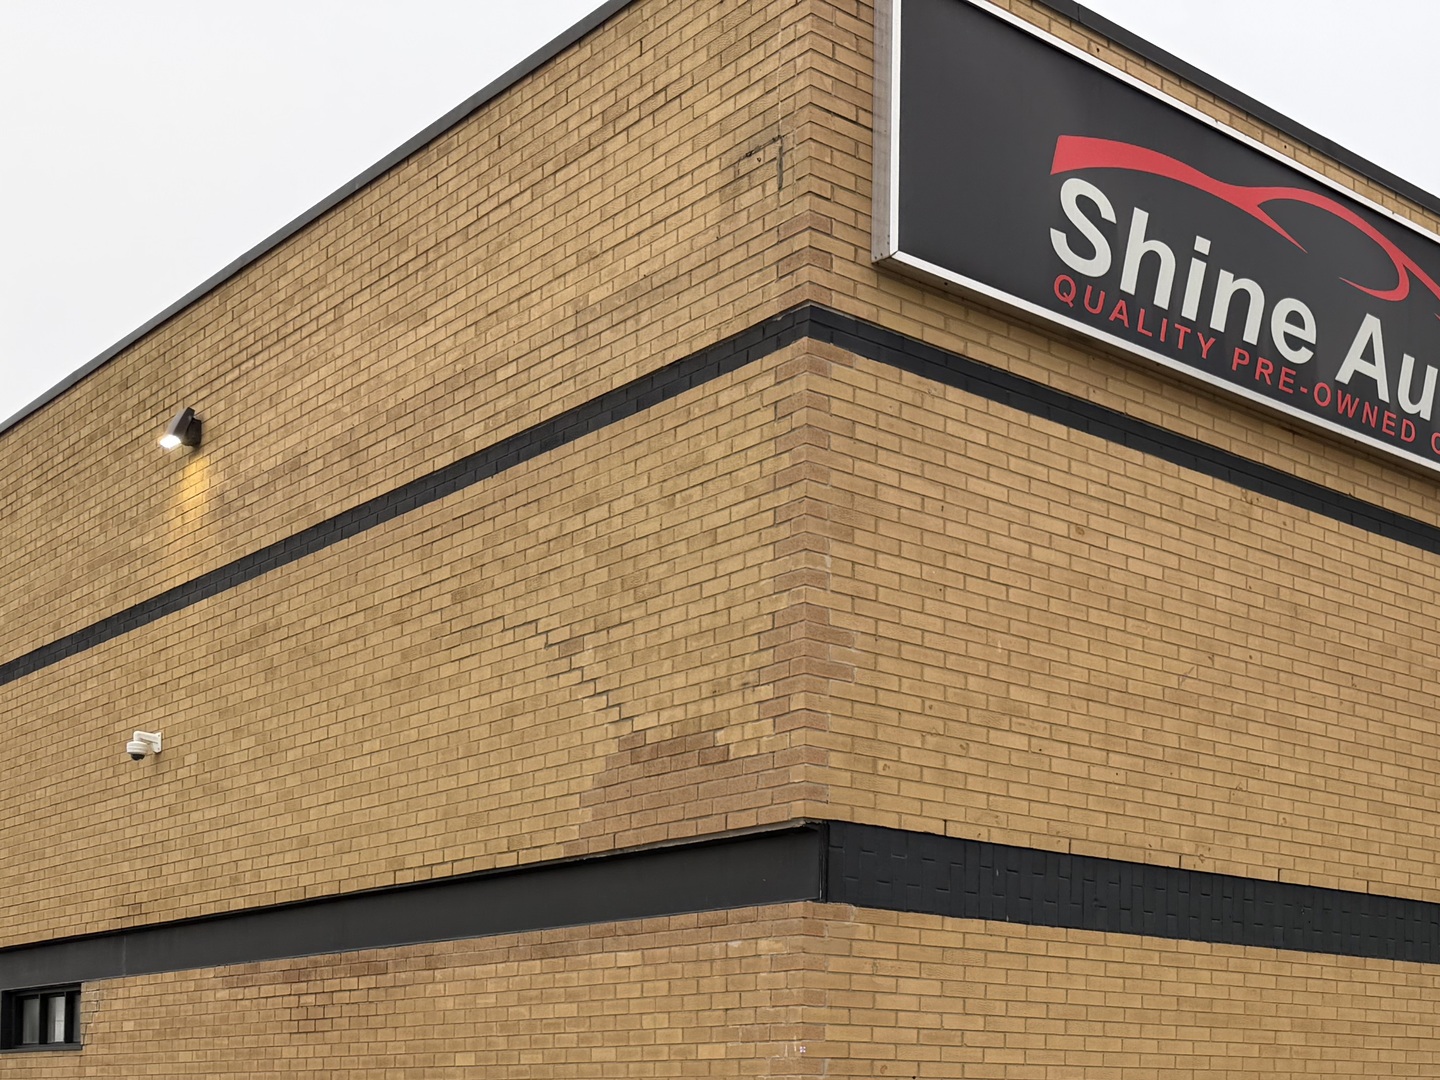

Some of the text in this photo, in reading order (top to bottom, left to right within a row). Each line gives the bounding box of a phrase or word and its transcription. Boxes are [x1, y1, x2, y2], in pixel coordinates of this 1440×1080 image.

[1050, 177, 1317, 364] Shine
[1053, 274, 1216, 359] QUALITY
[1231, 347, 1417, 443] PRE-OWNED
